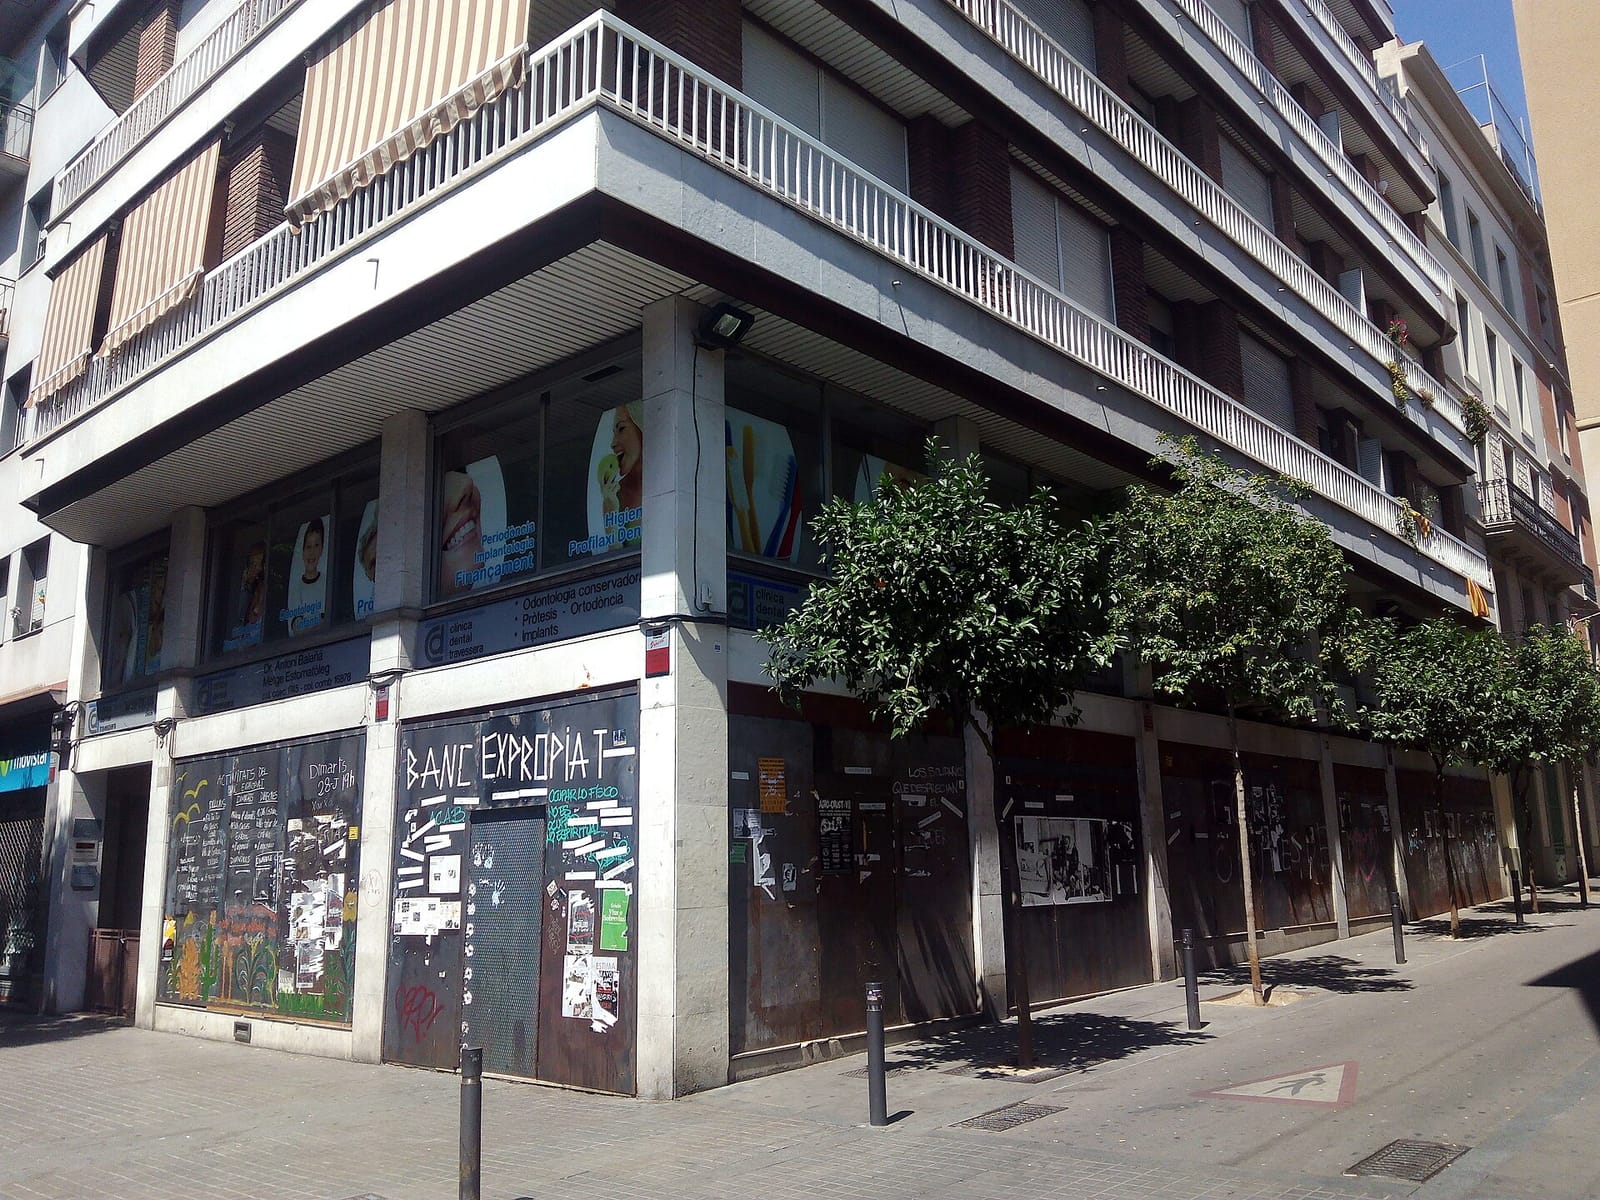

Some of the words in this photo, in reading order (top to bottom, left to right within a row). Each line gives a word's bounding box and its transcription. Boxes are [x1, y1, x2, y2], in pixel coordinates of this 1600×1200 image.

[474, 536, 536, 563] Implantologia
[568, 532, 615, 557] Profilaxi
[455, 551, 535, 587] Finançament
[522, 607, 558, 626] Pròtesis
[570, 592, 624, 615] Ortodòncia
[523, 587, 576, 611] Odontologia
[450, 620, 473, 634] clínica
[522, 625, 559, 642] Implants
[449, 632, 473, 647] dental
[449, 645, 484, 660] travessera
[13, 751, 48, 770] movistar
[308, 756, 348, 780] Dimarts
[406, 743, 474, 791] BANC
